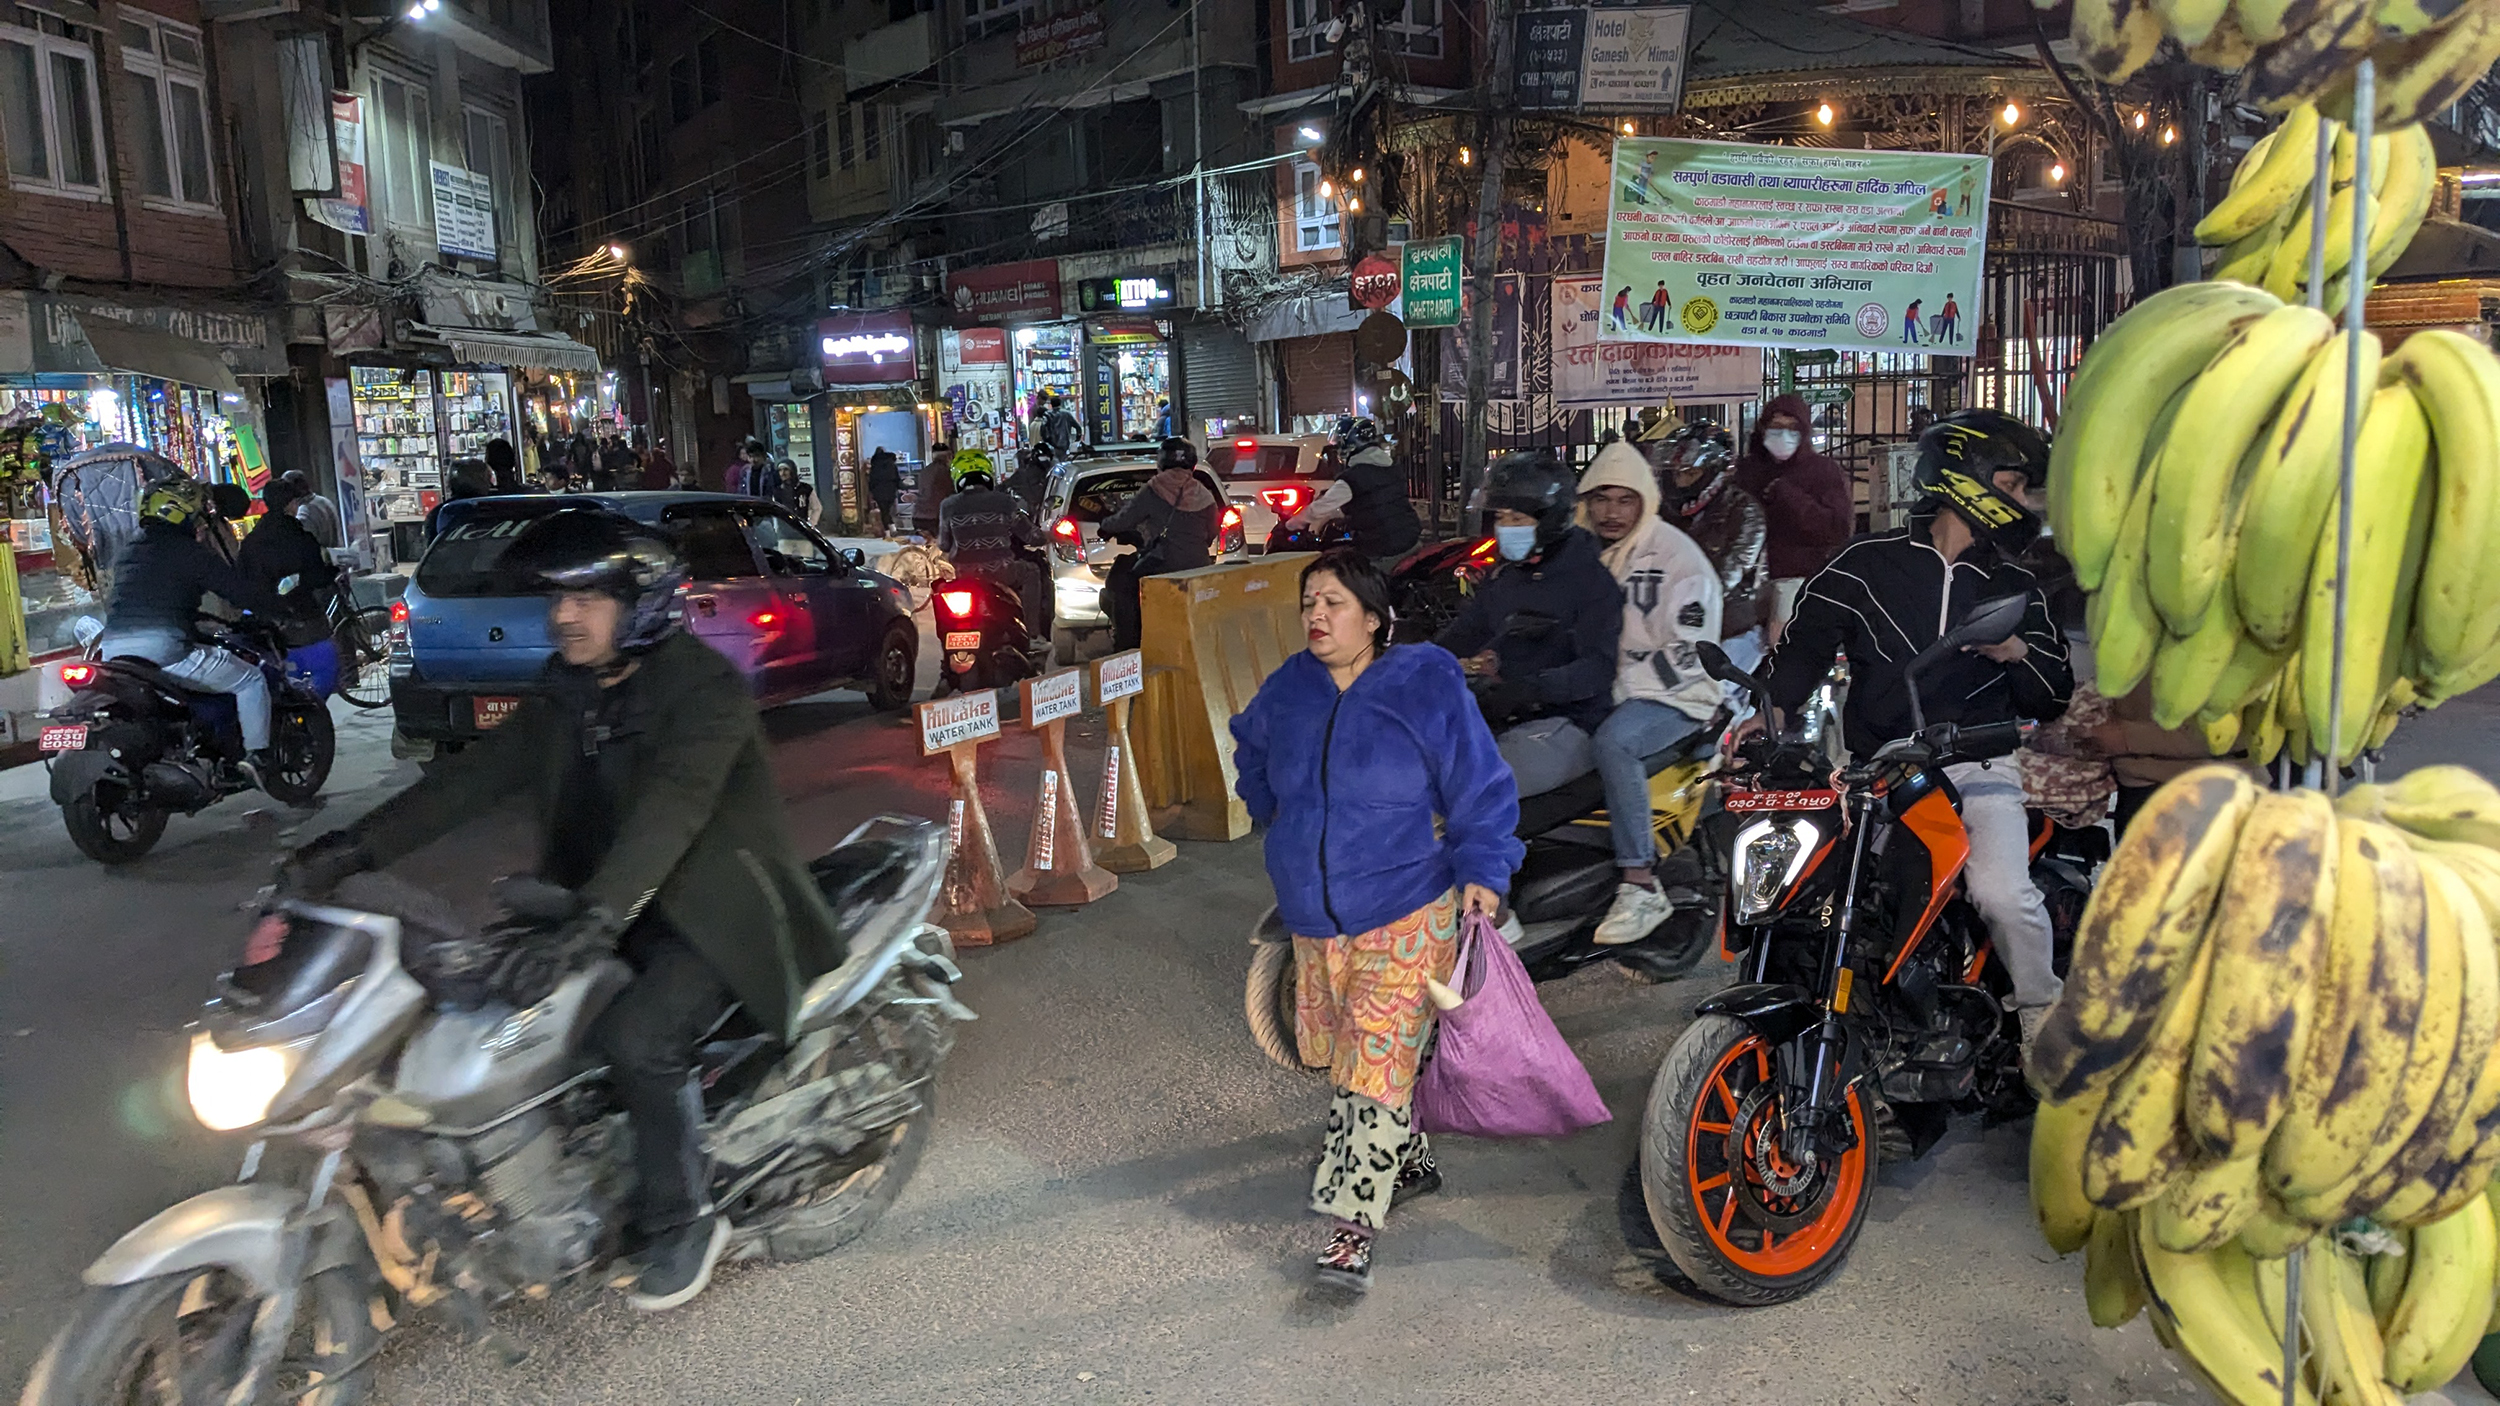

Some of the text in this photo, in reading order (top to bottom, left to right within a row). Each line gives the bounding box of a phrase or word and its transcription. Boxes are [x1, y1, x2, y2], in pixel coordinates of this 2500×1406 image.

[1594, 19, 1626, 38] Hotel
[1591, 45, 1679, 63] Ganesh Himal
[1711, 171, 1754, 187] वडावासी
[1758, 173, 1780, 188] तथा
[1893, 181, 1926, 195] अपिल
[1355, 273, 1397, 290] STOP
[1409, 266, 1452, 293] क्षेत्रपाटी
[1696, 272, 1873, 291] वृहत जनचेतना अभियान
[975, 287, 1018, 305] HUAWEI
[1408, 298, 1454, 319] CHHETRAPATI
[1740, 326, 1756, 334] वडा
[1771, 327, 1783, 335] १७
[1102, 676, 1140, 696] WATER TANK
[1034, 696, 1078, 719] WATER TANK
[929, 717, 994, 744] WATER TANK
